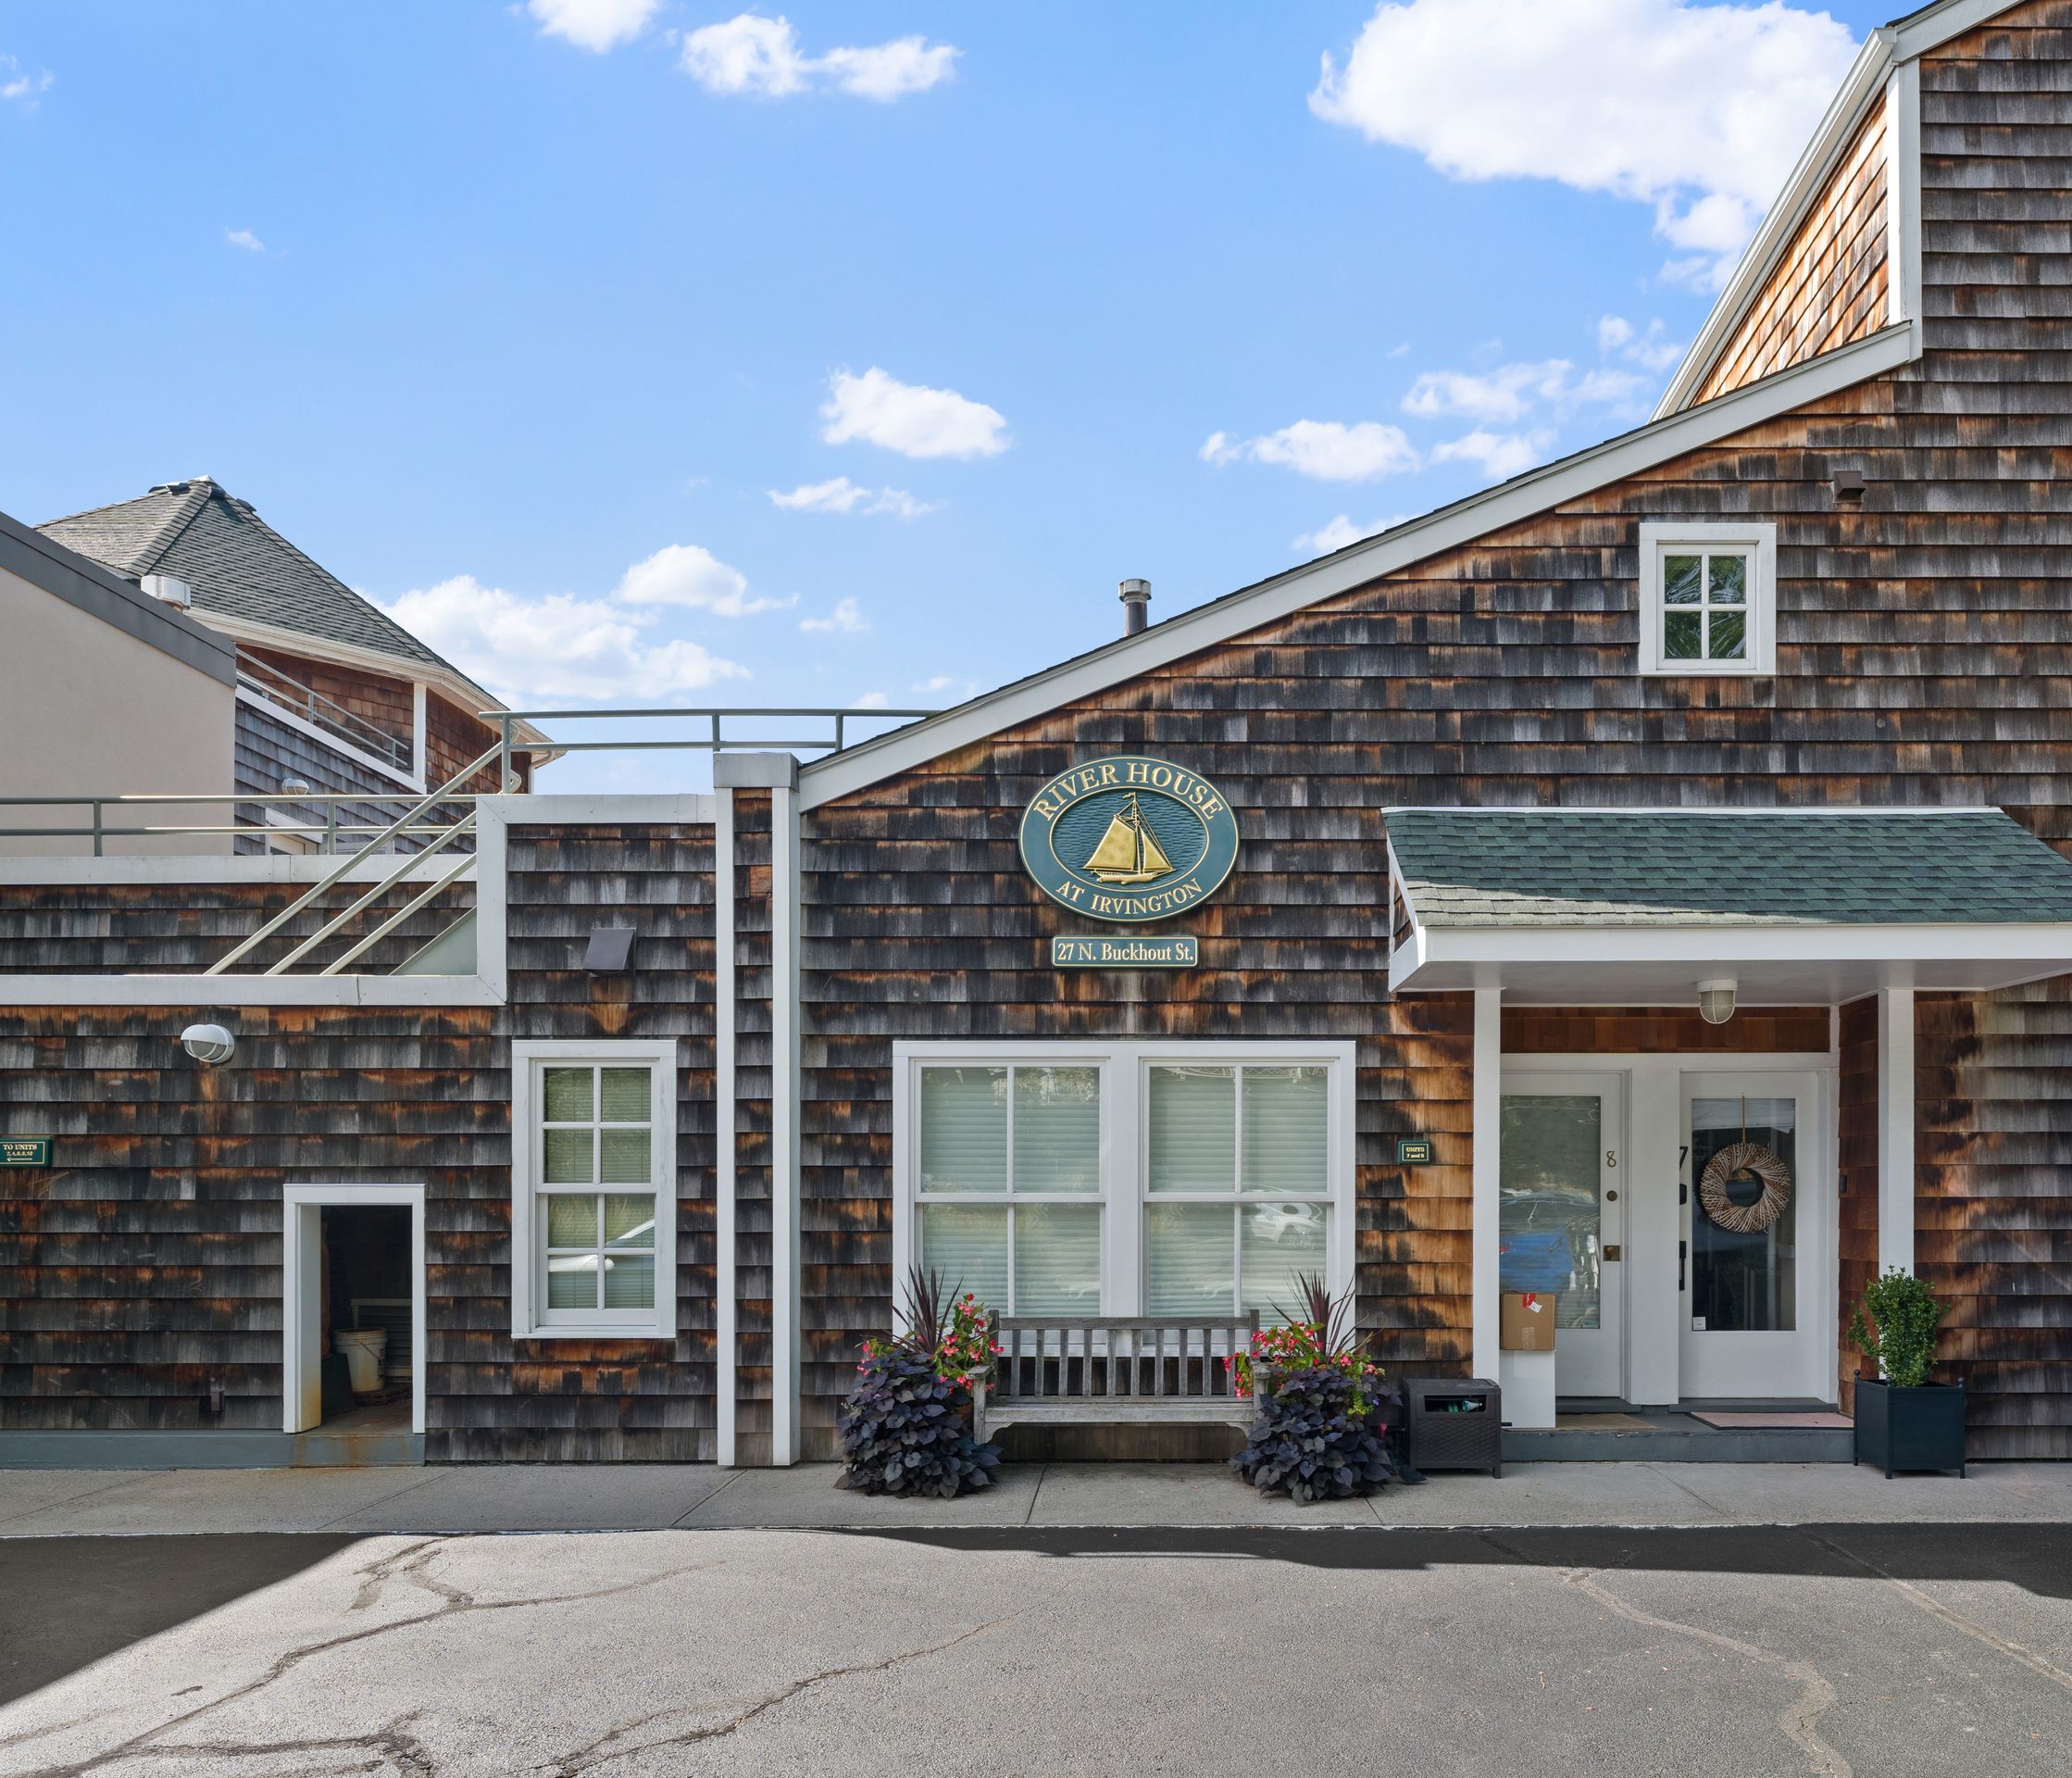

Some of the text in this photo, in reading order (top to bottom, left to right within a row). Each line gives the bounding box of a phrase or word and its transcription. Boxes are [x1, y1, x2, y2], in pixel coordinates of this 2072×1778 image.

[1033, 762, 1224, 821] RIVER HOUSE
[1055, 878, 1203, 915] AT IRVINGTON
[1057, 943, 1193, 961] 27 N. Buckhout St.
[1605, 1150, 1617, 1168] 8
[1679, 1146, 1689, 1171] 7
